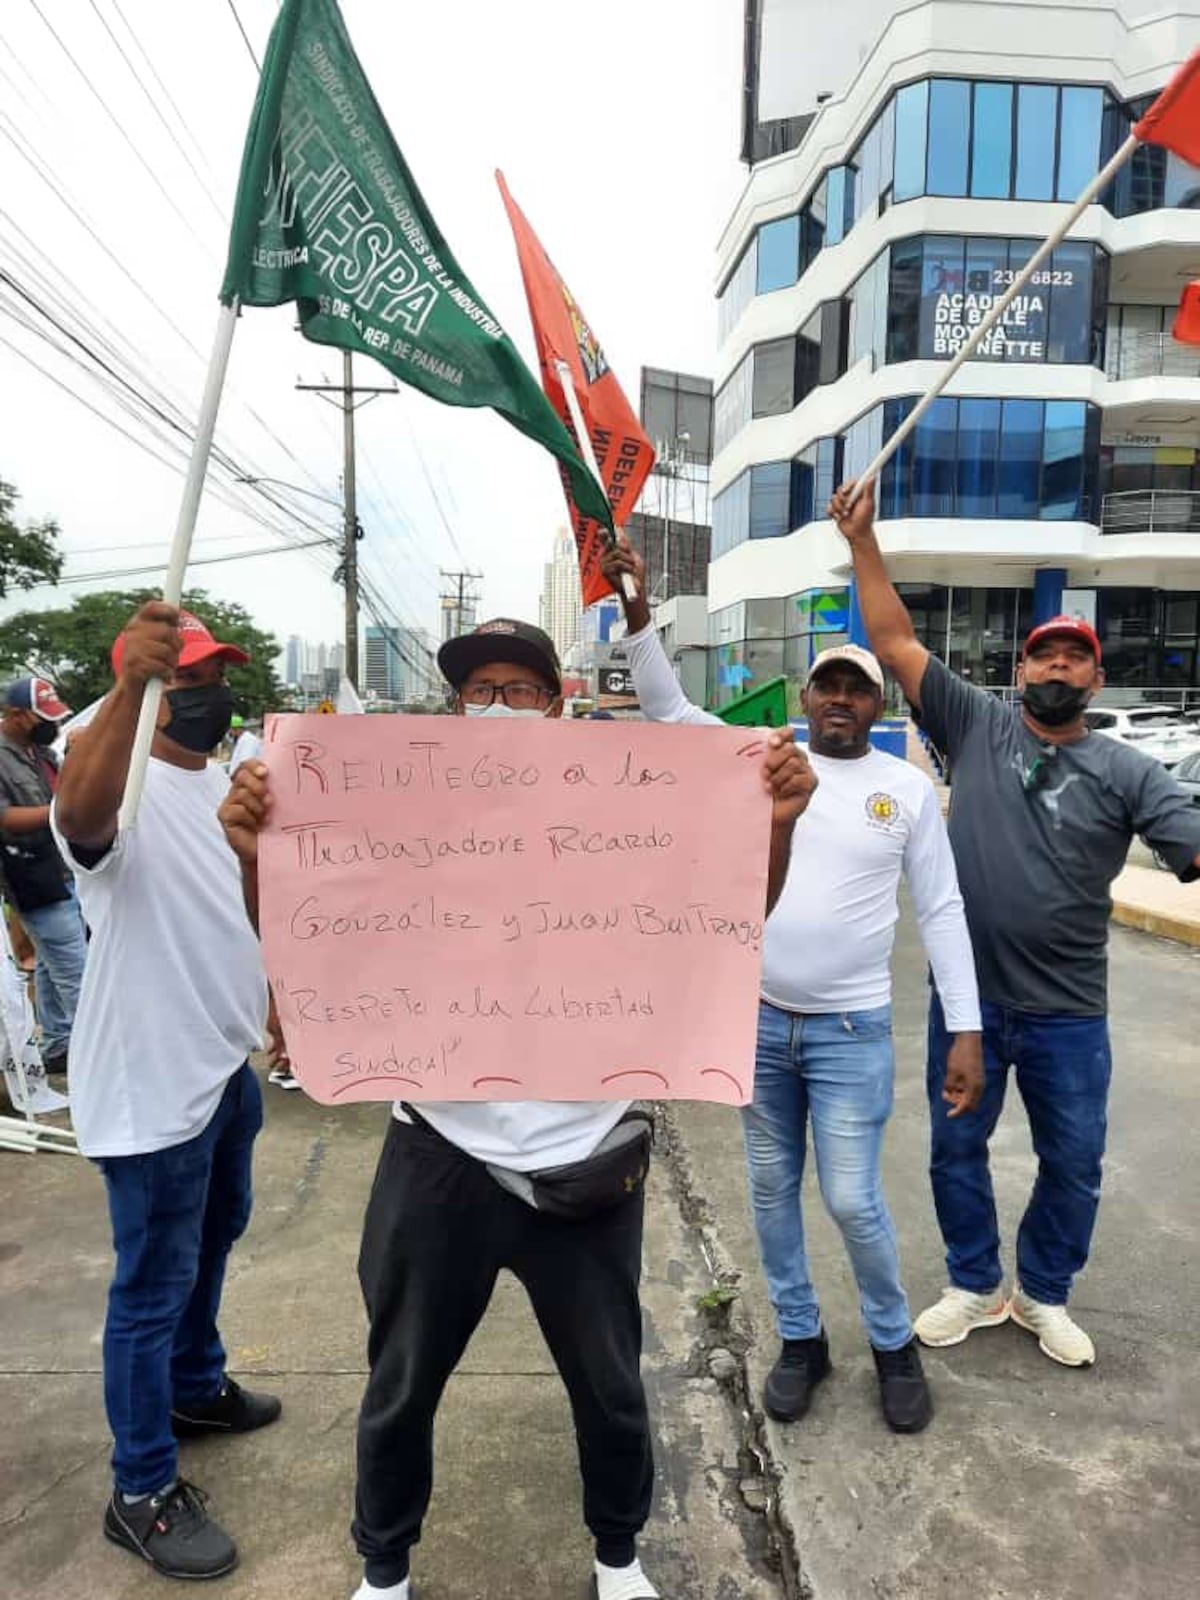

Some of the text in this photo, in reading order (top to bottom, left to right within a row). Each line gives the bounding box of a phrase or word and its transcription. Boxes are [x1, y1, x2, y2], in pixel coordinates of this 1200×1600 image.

[308, 42, 357, 124] SINDICATO
[350, 124, 372, 147] DE
[362, 145, 429, 256] TRABAJADORES
[422, 253, 443, 274] DE
[435, 271, 454, 290] LA
[1030, 270, 1074, 286] 6822
[331, 297, 351, 320] DE
[362, 326, 391, 351] REP.
[392, 338, 413, 360] DE
[934, 308, 1027, 326] DE BILE
[933, 338, 1043, 357] BRNETTE
[563, 763, 599, 787] a
[613, 750, 680, 788] los
[502, 912, 522, 943] y
